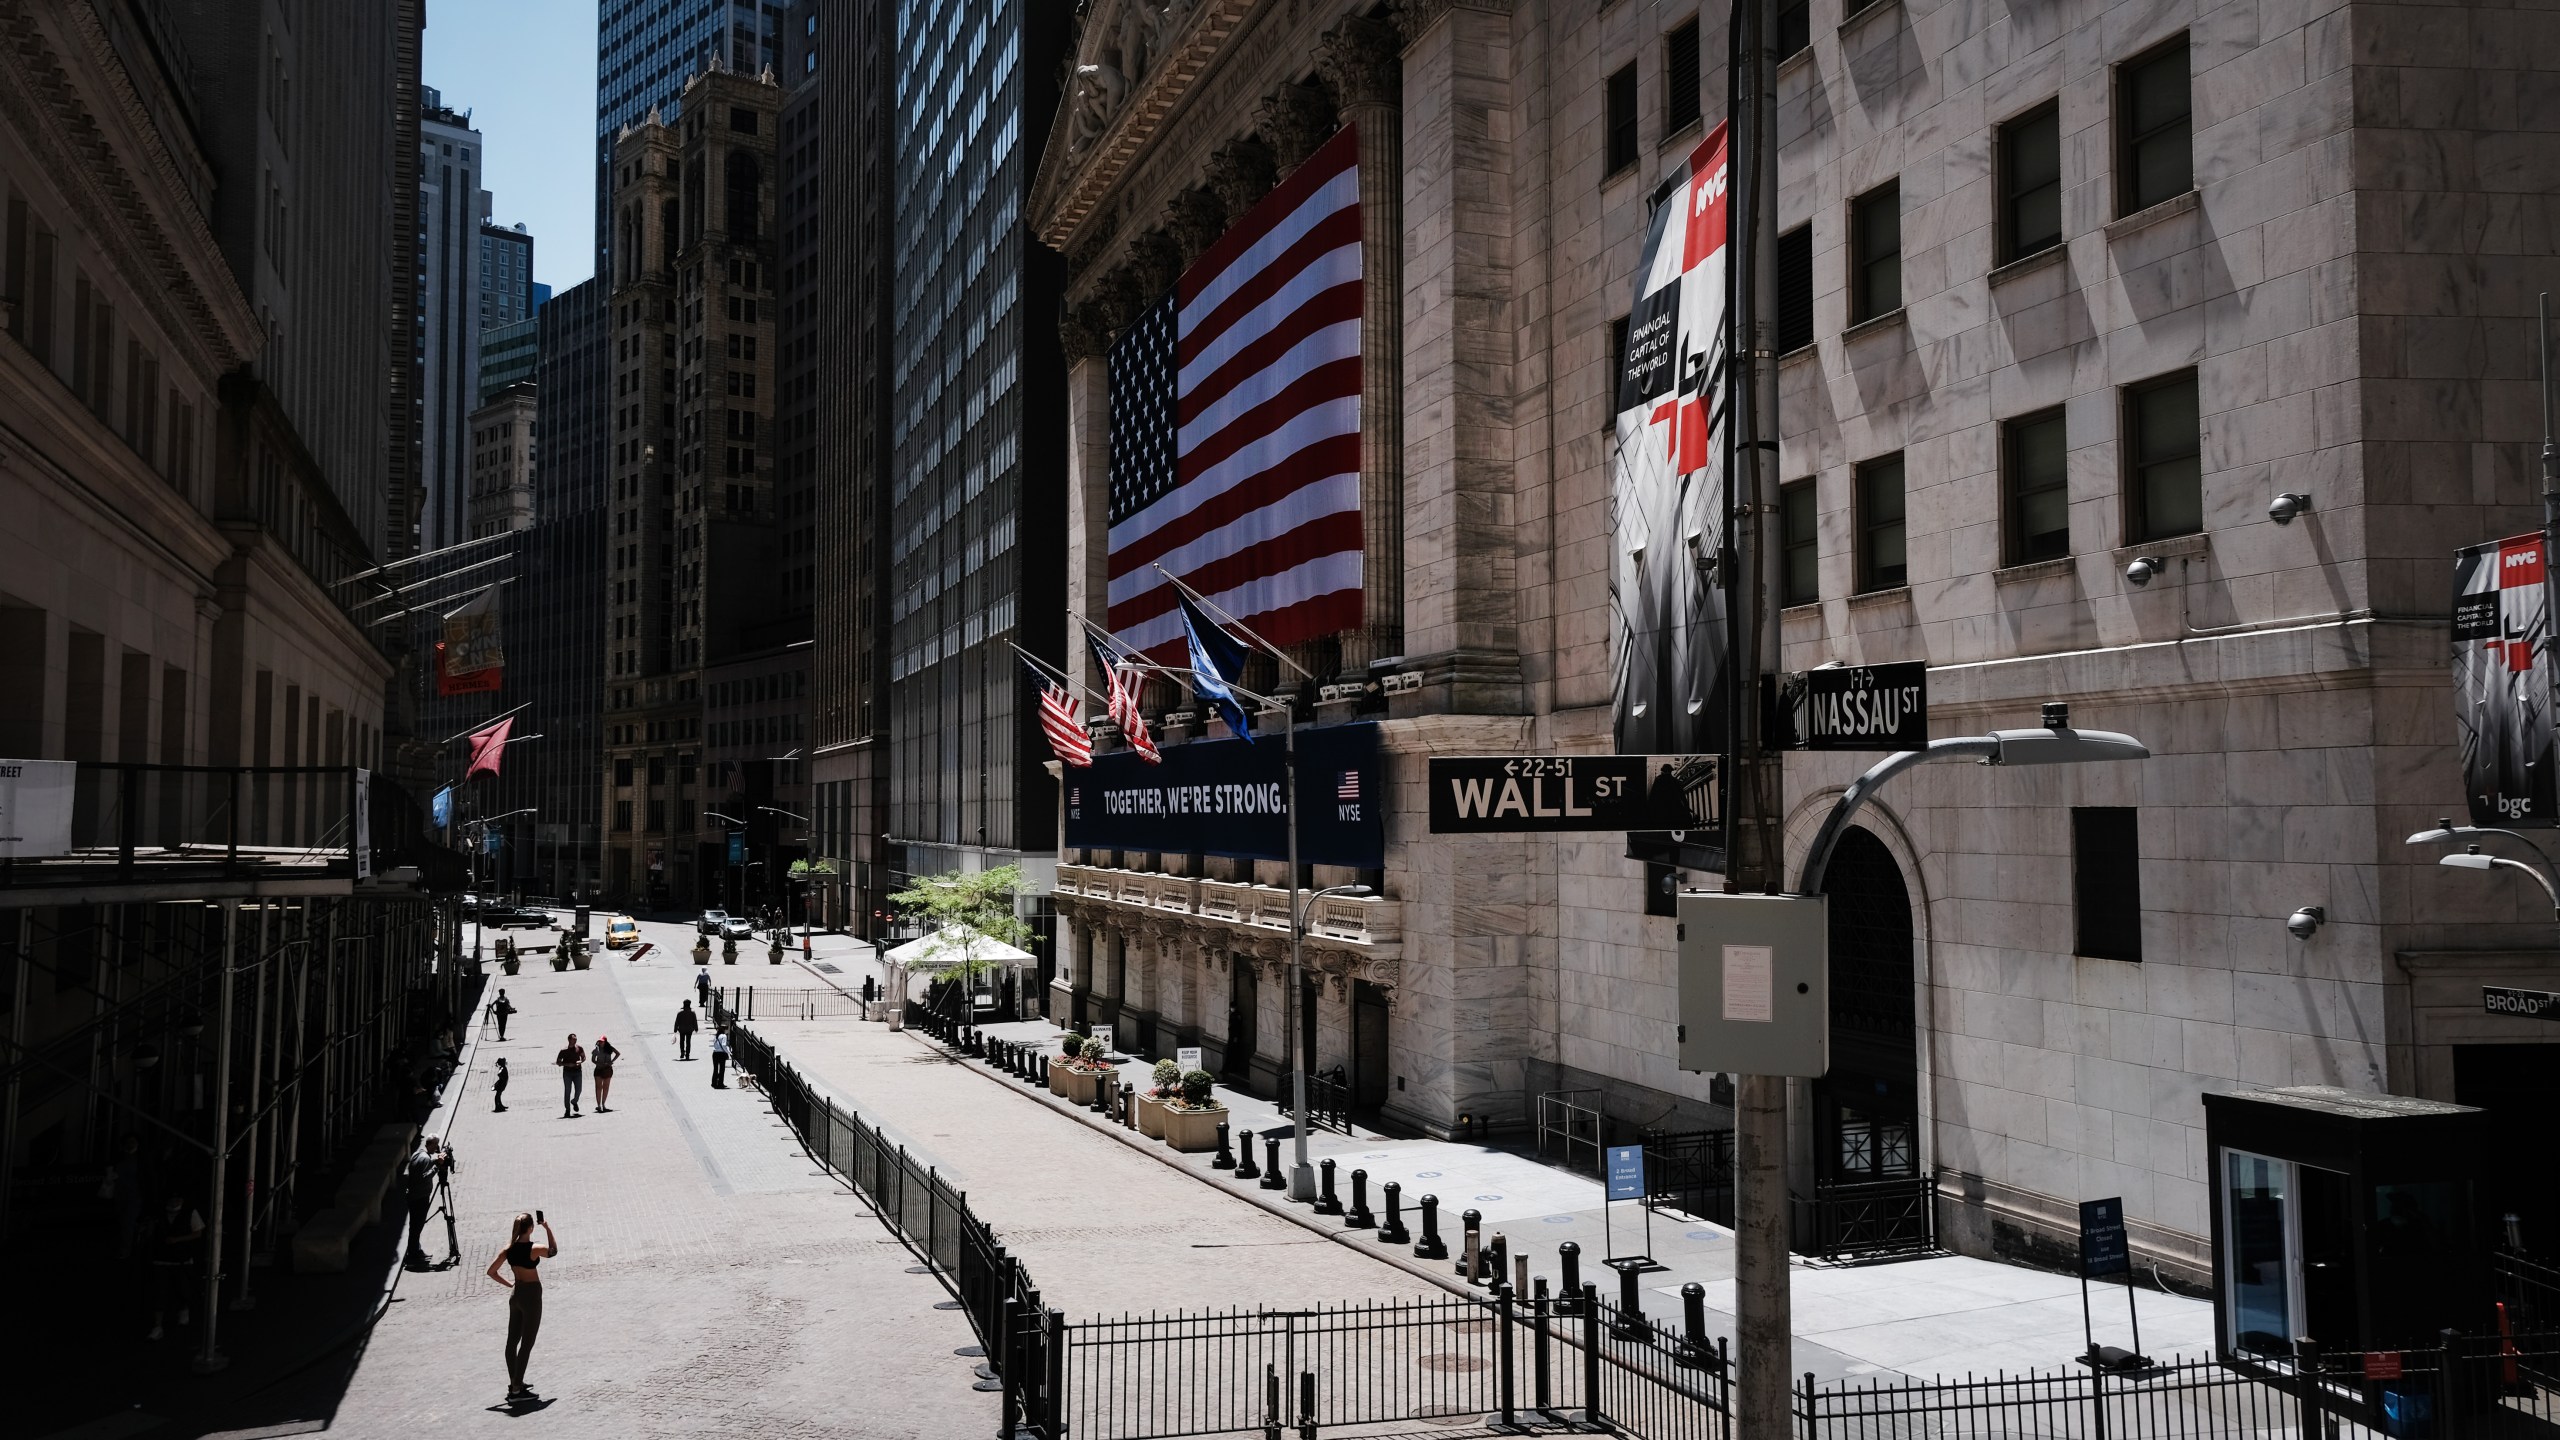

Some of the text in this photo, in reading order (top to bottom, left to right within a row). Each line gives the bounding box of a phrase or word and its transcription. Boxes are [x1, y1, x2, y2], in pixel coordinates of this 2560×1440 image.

[1695, 162, 1727, 218] NYC
[1632, 311, 1671, 344] FINANCIAL
[1630, 330, 1670, 362] CAPITAL OF
[1628, 351, 1668, 381] THE WORLD
[2506, 550, 2537, 568] NYC
[2457, 603, 2494, 614] FINANCIAL
[2457, 610, 2494, 622] CAPITAL OF
[2470, 619, 2494, 628] WORLD
[1849, 668, 1864, 689] 1-7
[1814, 686, 1920, 735] NASSAU ST
[0, 765, 22, 778] REET
[1522, 758, 1573, 777] 22-51
[1104, 782, 1287, 819] TOGETHER, WE'RE STRONG.
[1451, 776, 1626, 819] WALL ST
[2497, 792, 2531, 819] bgc
[1339, 803, 1361, 822] NYSE
[2486, 994, 2549, 1014] BROAD ST
